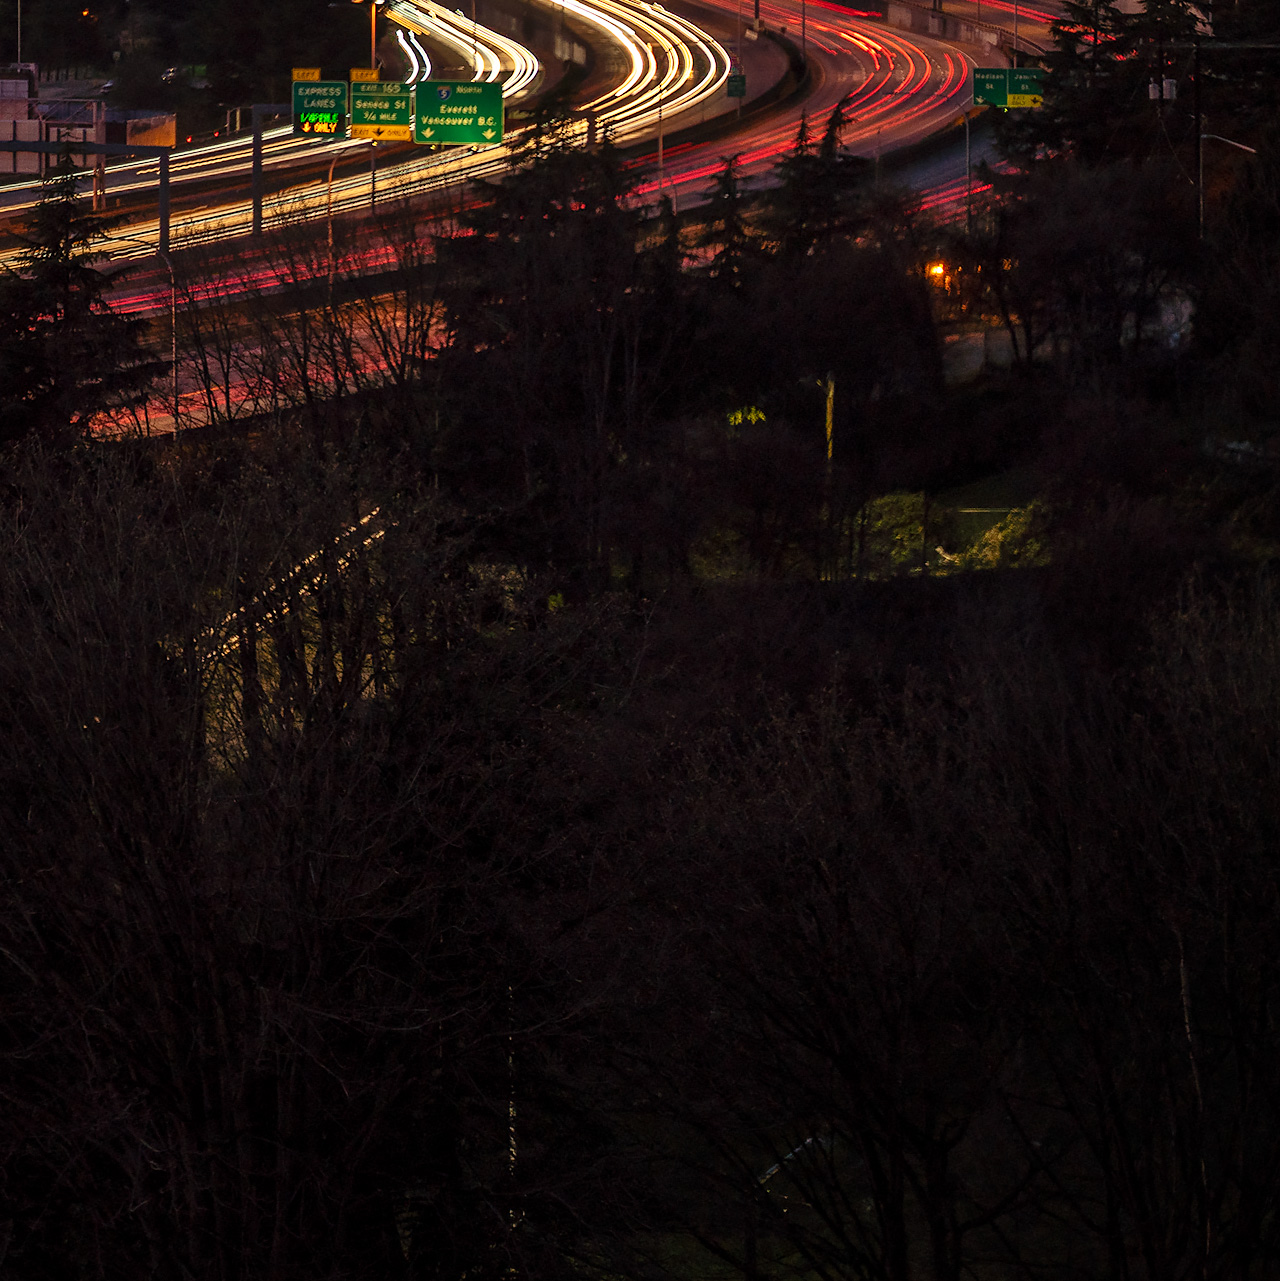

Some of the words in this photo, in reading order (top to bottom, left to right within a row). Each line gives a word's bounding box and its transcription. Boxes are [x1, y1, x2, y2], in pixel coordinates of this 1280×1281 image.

[298, 87, 342, 97] EXPRESS
[303, 98, 336, 109] LANES
[355, 99, 390, 110] Seneca
[394, 99, 407, 110] St
[439, 104, 478, 114] Everett
[379, 112, 398, 121] MILE
[420, 115, 474, 126] Vancouver
[477, 116, 497, 127] B.C.
[313, 122, 338, 133] ONLY
